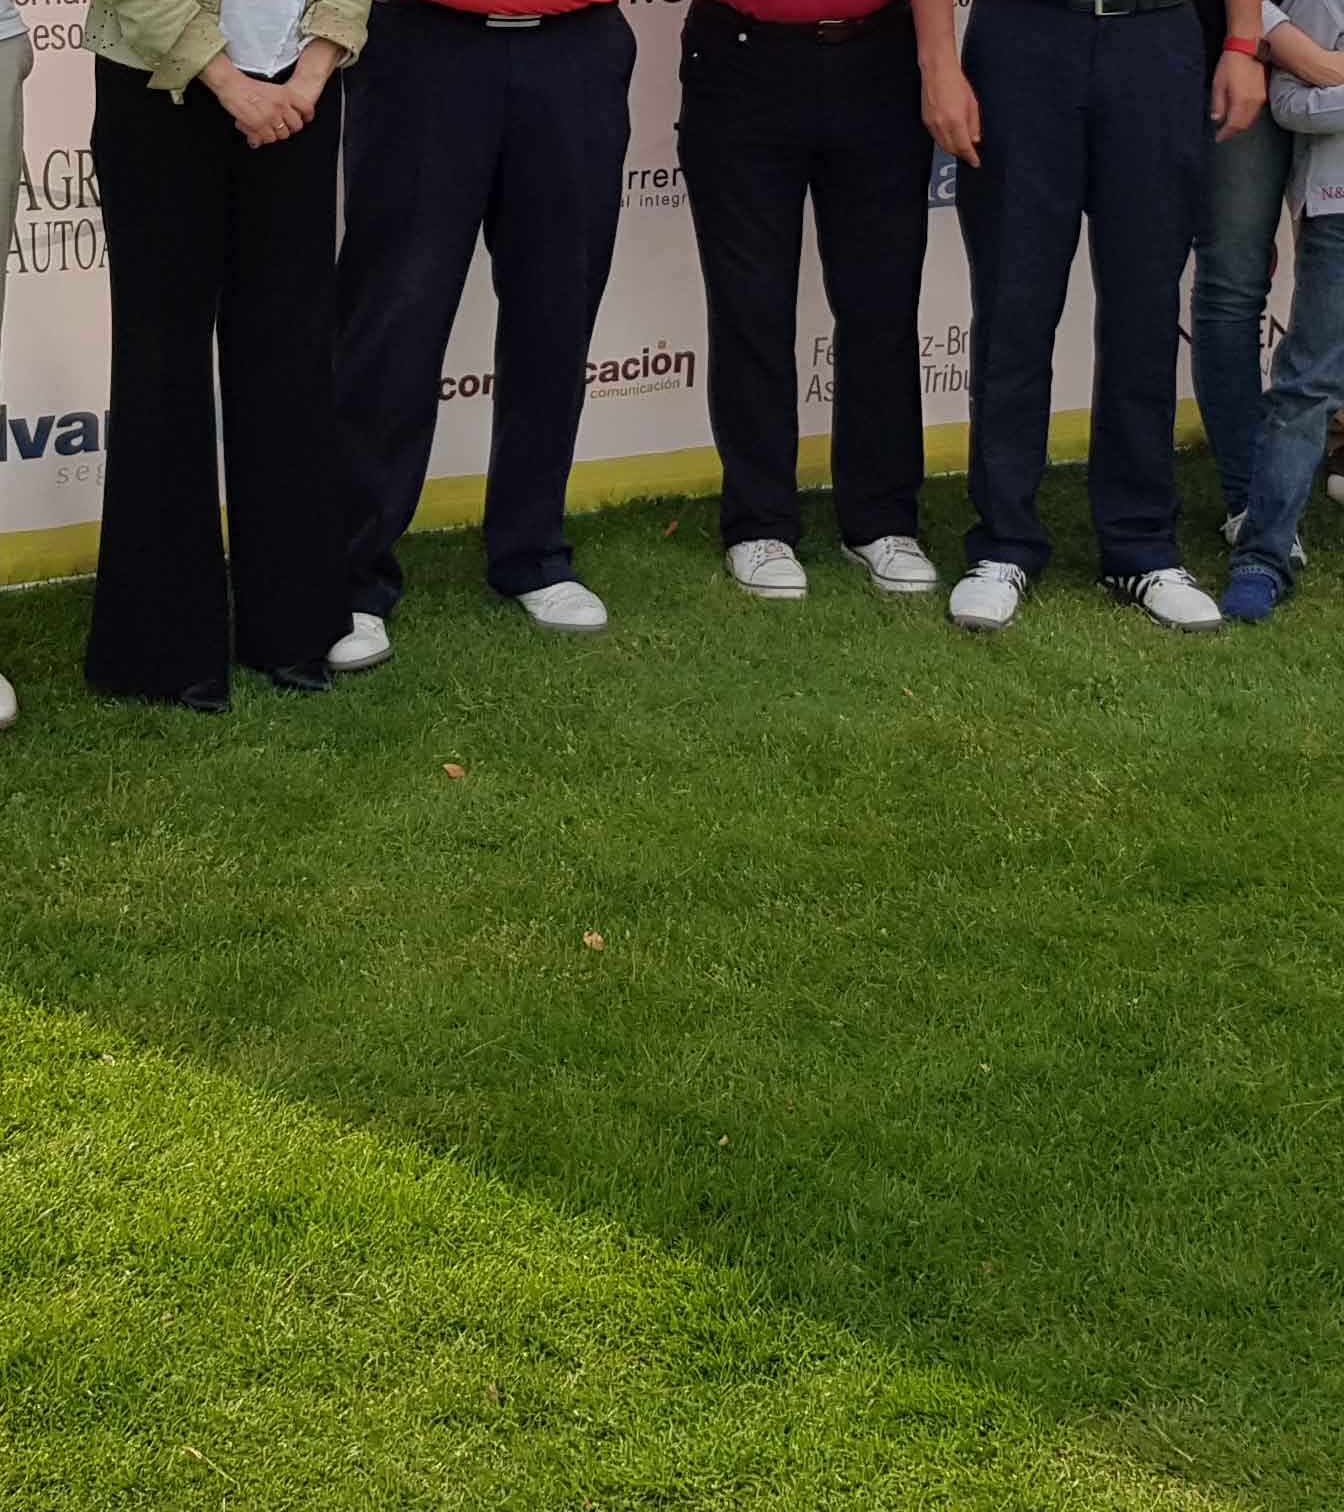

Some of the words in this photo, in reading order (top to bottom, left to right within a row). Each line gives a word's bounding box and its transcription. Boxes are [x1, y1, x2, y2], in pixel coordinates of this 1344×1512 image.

[33, 22, 84, 51] eso
[18, 148, 103, 212] AGR
[639, 193, 687, 210] integr
[589, 377, 681, 400] comunicación
